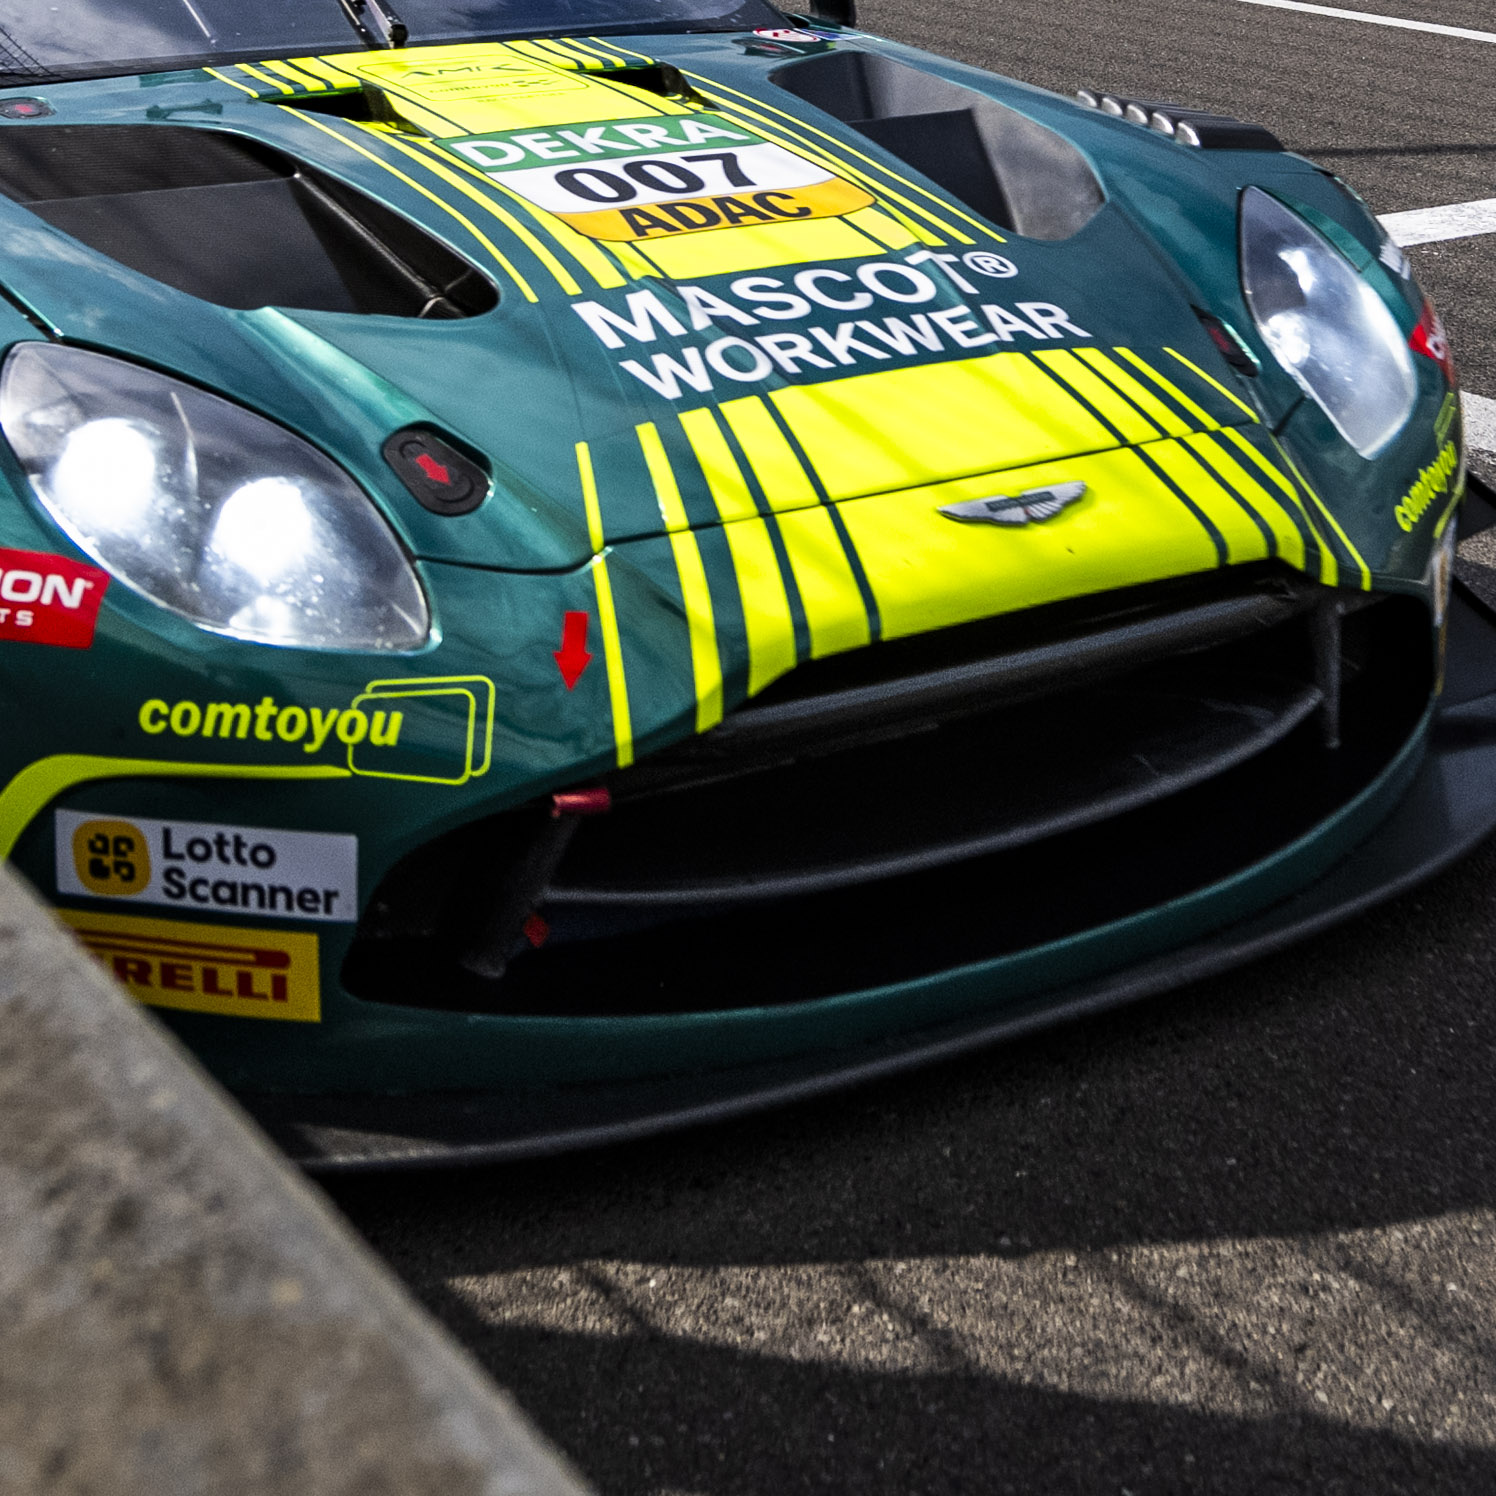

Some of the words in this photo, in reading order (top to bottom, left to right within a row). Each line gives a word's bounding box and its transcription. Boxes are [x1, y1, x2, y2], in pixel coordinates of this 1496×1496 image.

[450, 115, 753, 169] DEKRA
[553, 152, 760, 206] 007
[630, 192, 813, 238] ADAC
[619, 301, 1093, 402] WORKWEAR
[138, 697, 403, 753] comtoyou
[161, 826, 277, 869] Lotto
[161, 866, 340, 916] Scanner
